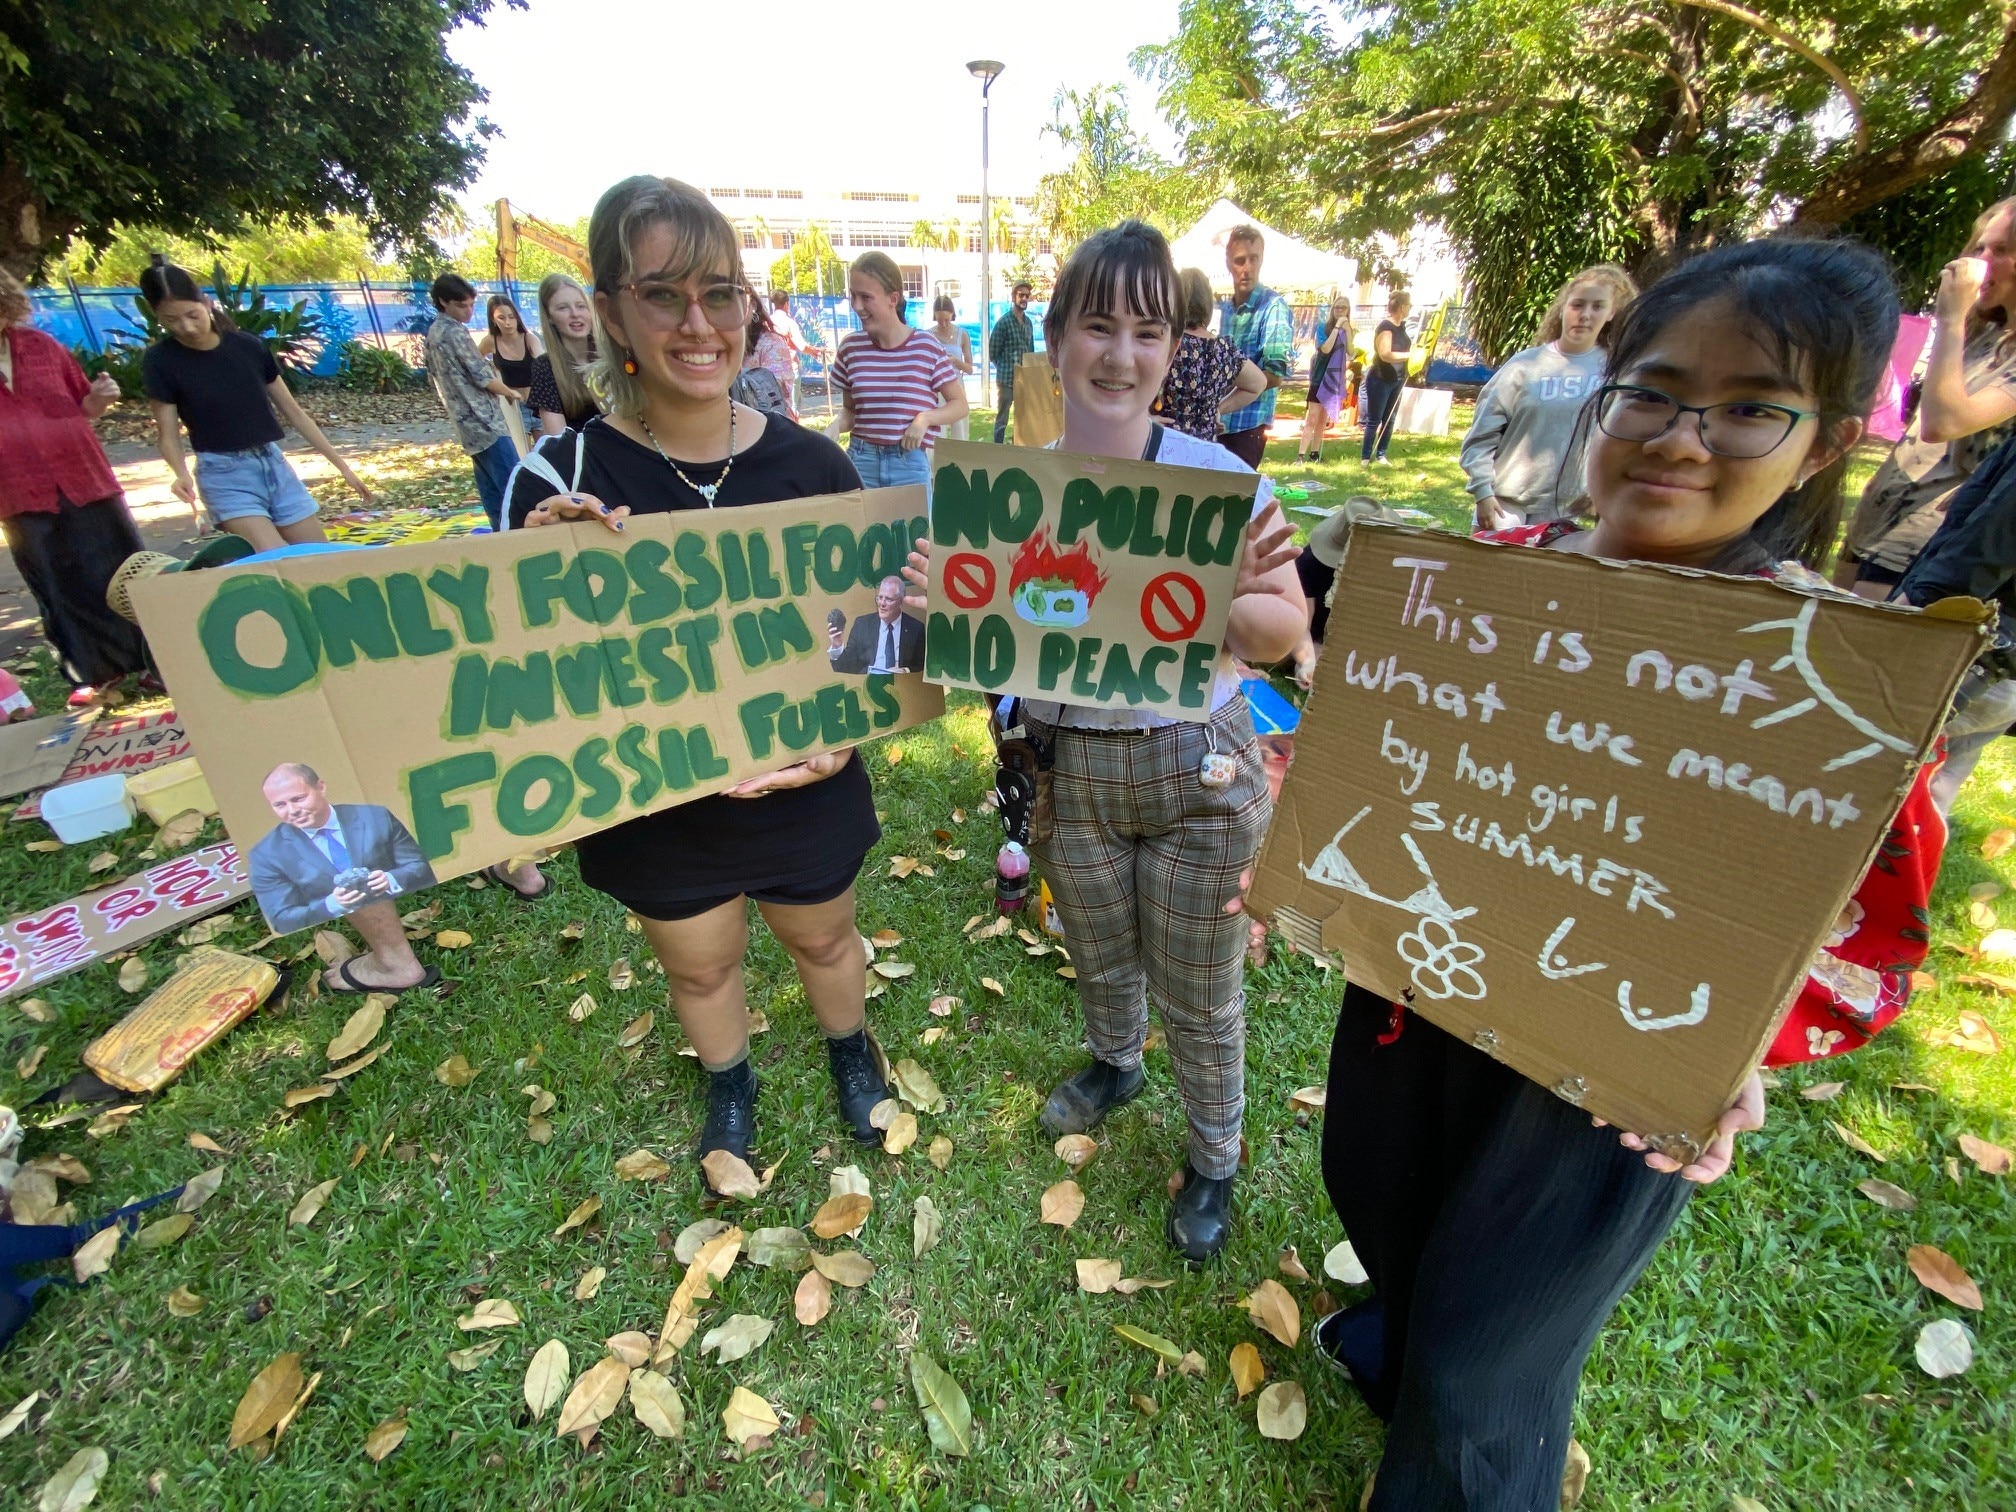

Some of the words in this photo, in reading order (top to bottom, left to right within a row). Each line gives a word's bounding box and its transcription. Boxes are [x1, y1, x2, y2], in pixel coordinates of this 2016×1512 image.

[932, 463, 1043, 549] NO
[1057, 478, 1255, 567] POLICY
[198, 558, 494, 697] ONLY
[513, 527, 781, 630] FOSSIL
[439, 608, 722, 740] INVEST
[728, 601, 819, 675] IN
[926, 612, 1016, 689] NO
[1037, 632, 1216, 708] PEACE
[1392, 557, 1498, 654] This
[1532, 600, 1592, 672] is
[1626, 650, 1775, 715] not
[399, 721, 729, 860] FOSSIL
[737, 674, 901, 760] FUELS
[1345, 650, 1506, 723] what
[1546, 710, 1643, 767] we
[1667, 748, 1861, 829] meant
[1381, 719, 1428, 795] by
[1455, 742, 1516, 797] hot
[1527, 784, 1645, 843] girls
[13, 905, 99, 982] SWIM
[92, 887, 162, 933] OR
[144, 857, 230, 910] NOW
